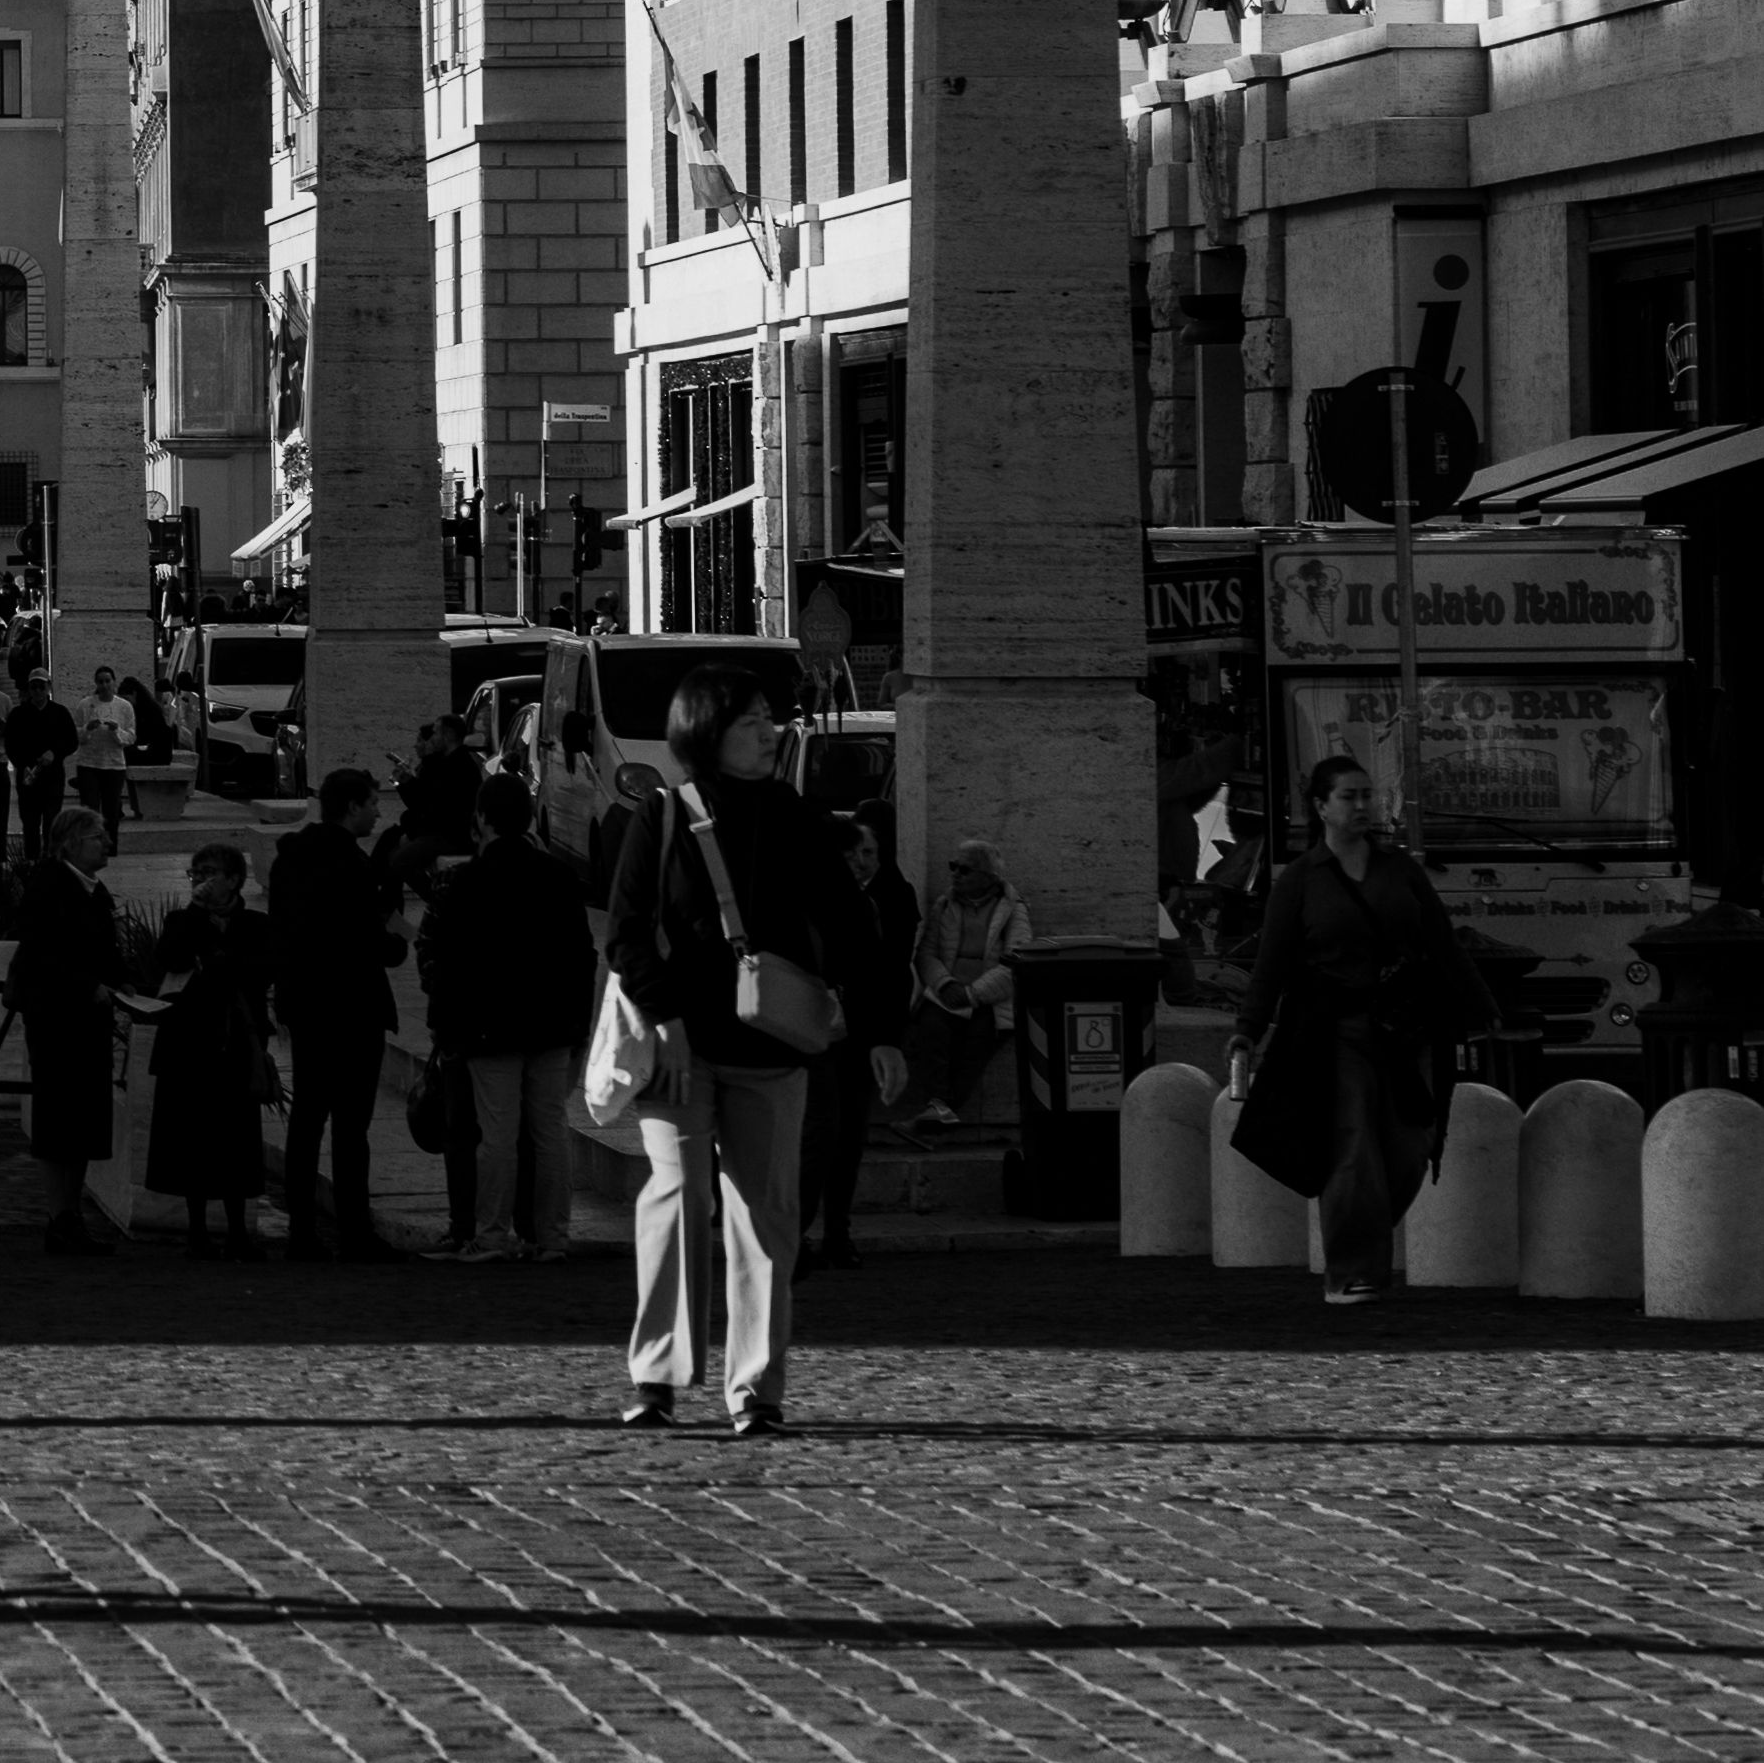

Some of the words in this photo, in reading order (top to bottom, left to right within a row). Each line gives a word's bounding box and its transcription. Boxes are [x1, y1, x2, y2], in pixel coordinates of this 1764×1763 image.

[1143, 577, 1244, 630] INKS
[1345, 582, 1374, 626] Il
[1513, 578, 1655, 625] Italiano
